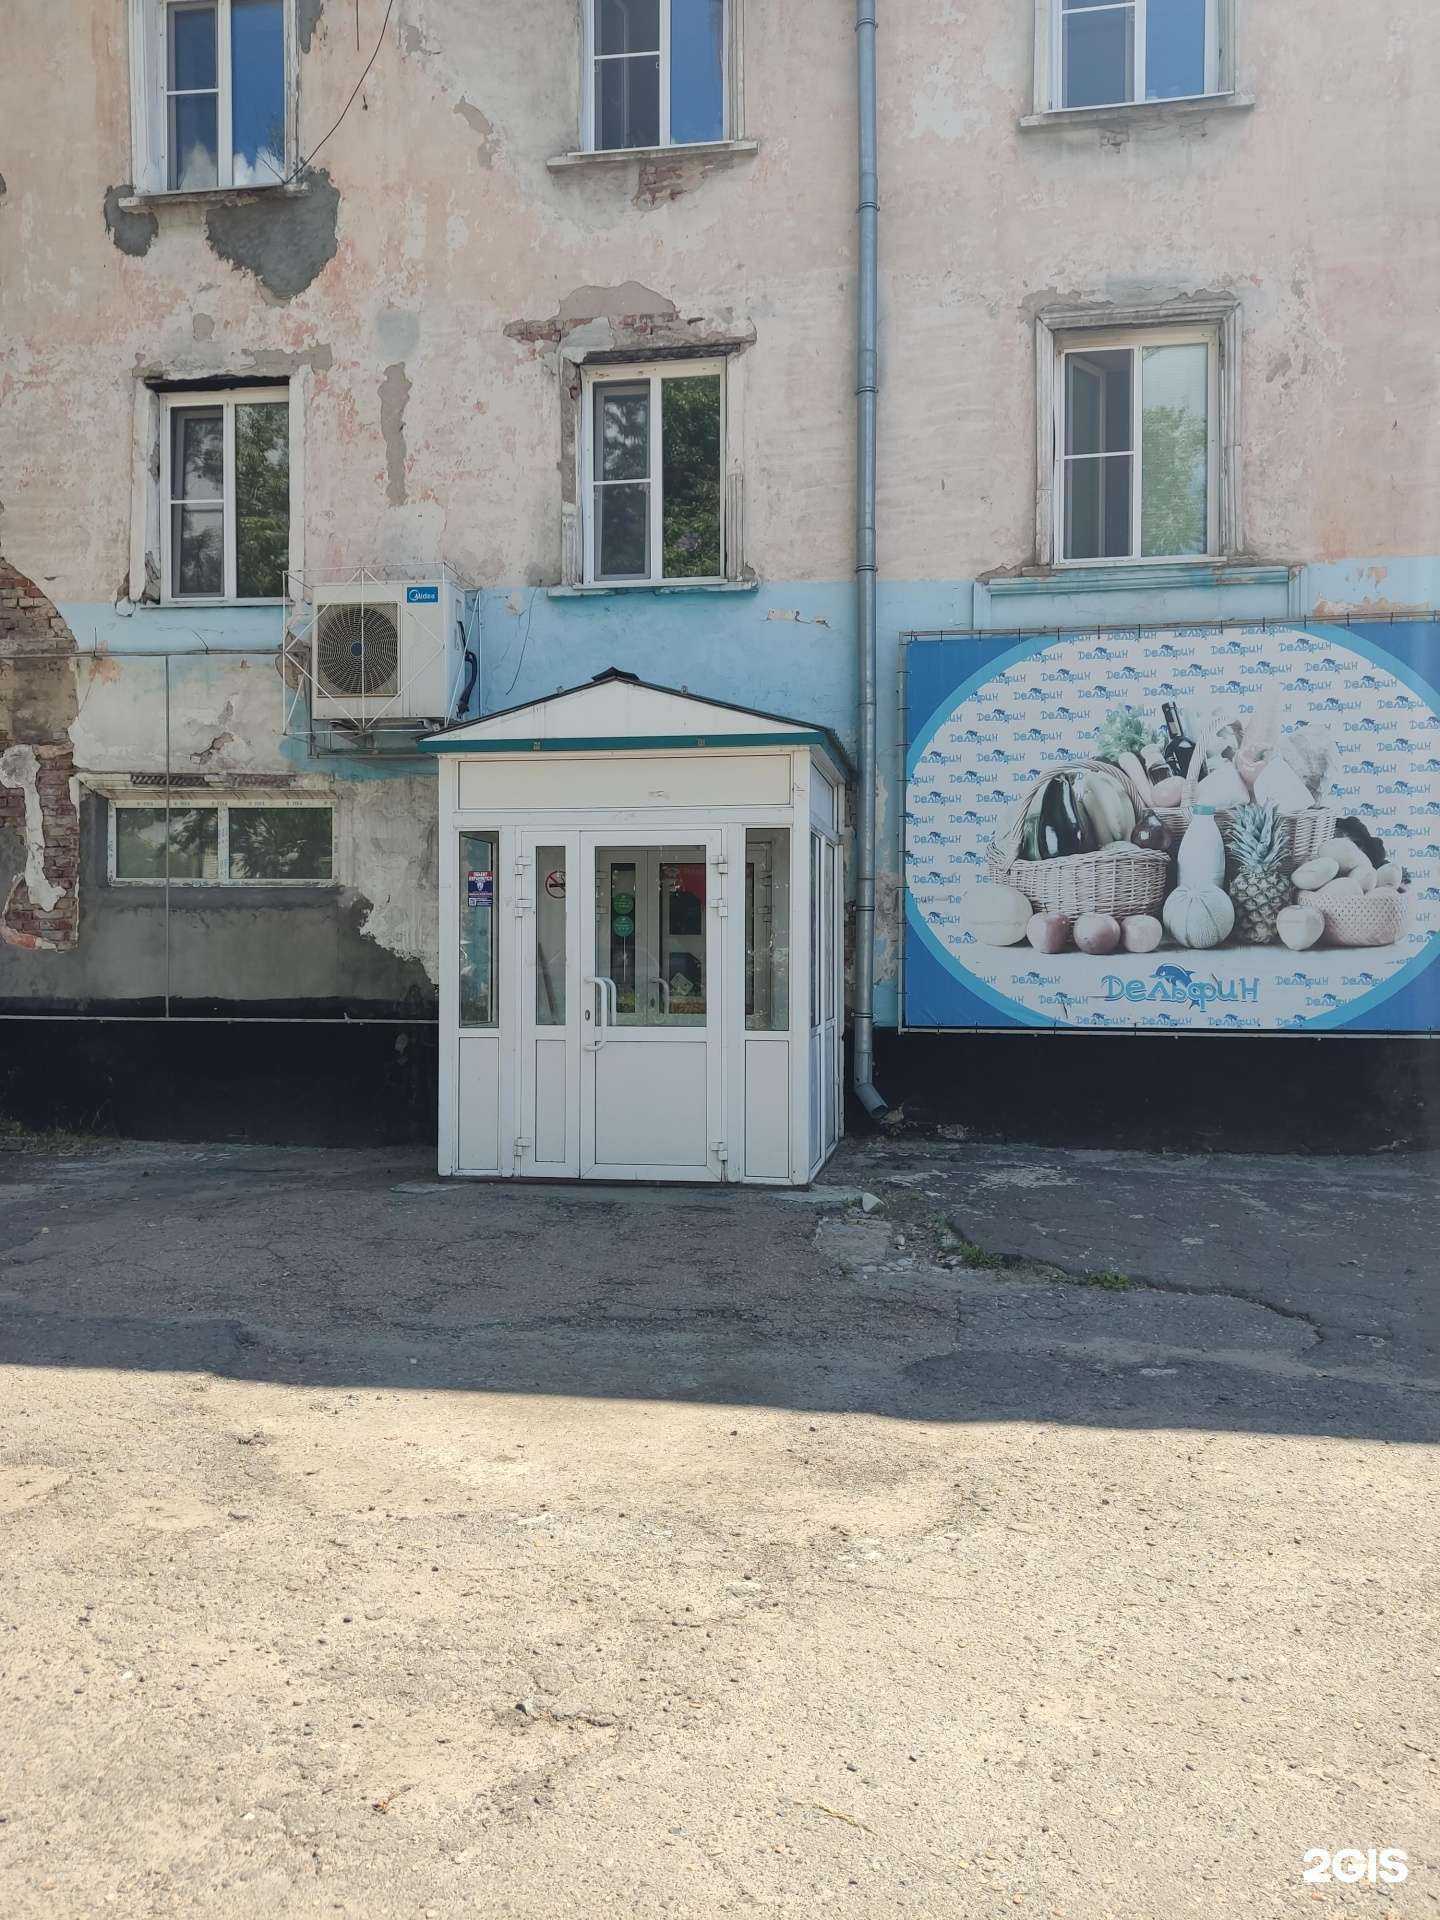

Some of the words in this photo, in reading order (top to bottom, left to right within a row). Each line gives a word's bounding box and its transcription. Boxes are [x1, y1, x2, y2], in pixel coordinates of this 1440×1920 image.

[1028, 652, 1063, 664] льфин
[1078, 650, 1128, 662] Дельфин
[1144, 647, 1195, 658] Дельфин
[1211, 644, 1262, 657] Дельфин
[1279, 641, 1332, 654] Дельфин
[990, 674, 1026, 685] льфин
[1040, 671, 1091, 684] Дельфин
[1106, 669, 1157, 680] Дельфин
[1173, 665, 1224, 678] Дельфин
[1240, 663, 1293, 675] Дельфин
[1305, 661, 1358, 674] Дельфин
[1013, 690, 1063, 702] Дельфин
[1078, 688, 1128, 700] Дельфин
[1144, 685, 1195, 697] Дельфин
[1210, 682, 1262, 696] Дельфин
[1344, 679, 1397, 691] Дельфин
[977, 711, 1026, 723] Дельфин
[1040, 710, 1090, 722] Дельфин
[1308, 700, 1362, 713] Дельфин
[1376, 698, 1427, 711] Дельфи
[950, 732, 999, 745] Дельфин
[1013, 730, 1062, 743] Дельфин
[1343, 721, 1398, 734] Дельфин
[921, 754, 962, 766] ельфин
[976, 752, 1026, 765] Дельфин
[1040, 751, 1090, 763] Дельфин
[1376, 741, 1431, 754] Дельфин
[949, 773, 998, 785] Дельфин
[1343, 763, 1397, 776] Дельфин
[913, 794, 962, 806] Дельфин
[1376, 784, 1431, 796] Дельфин
[949, 814, 998, 826] Дельфин
[1343, 805, 1396, 817] Дельфин
[913, 834, 961, 847] Дельфин
[1376, 826, 1431, 838] Дельфин
[913, 874, 961, 886] Дельфин
[926, 917, 960, 927] льфин
[1012, 975, 1061, 987] Дельфин
[1274, 975, 1329, 989] Дельфин
[1038, 995, 1088, 1007] Дельфин
[1100, 974, 1260, 1013] Дельфин
